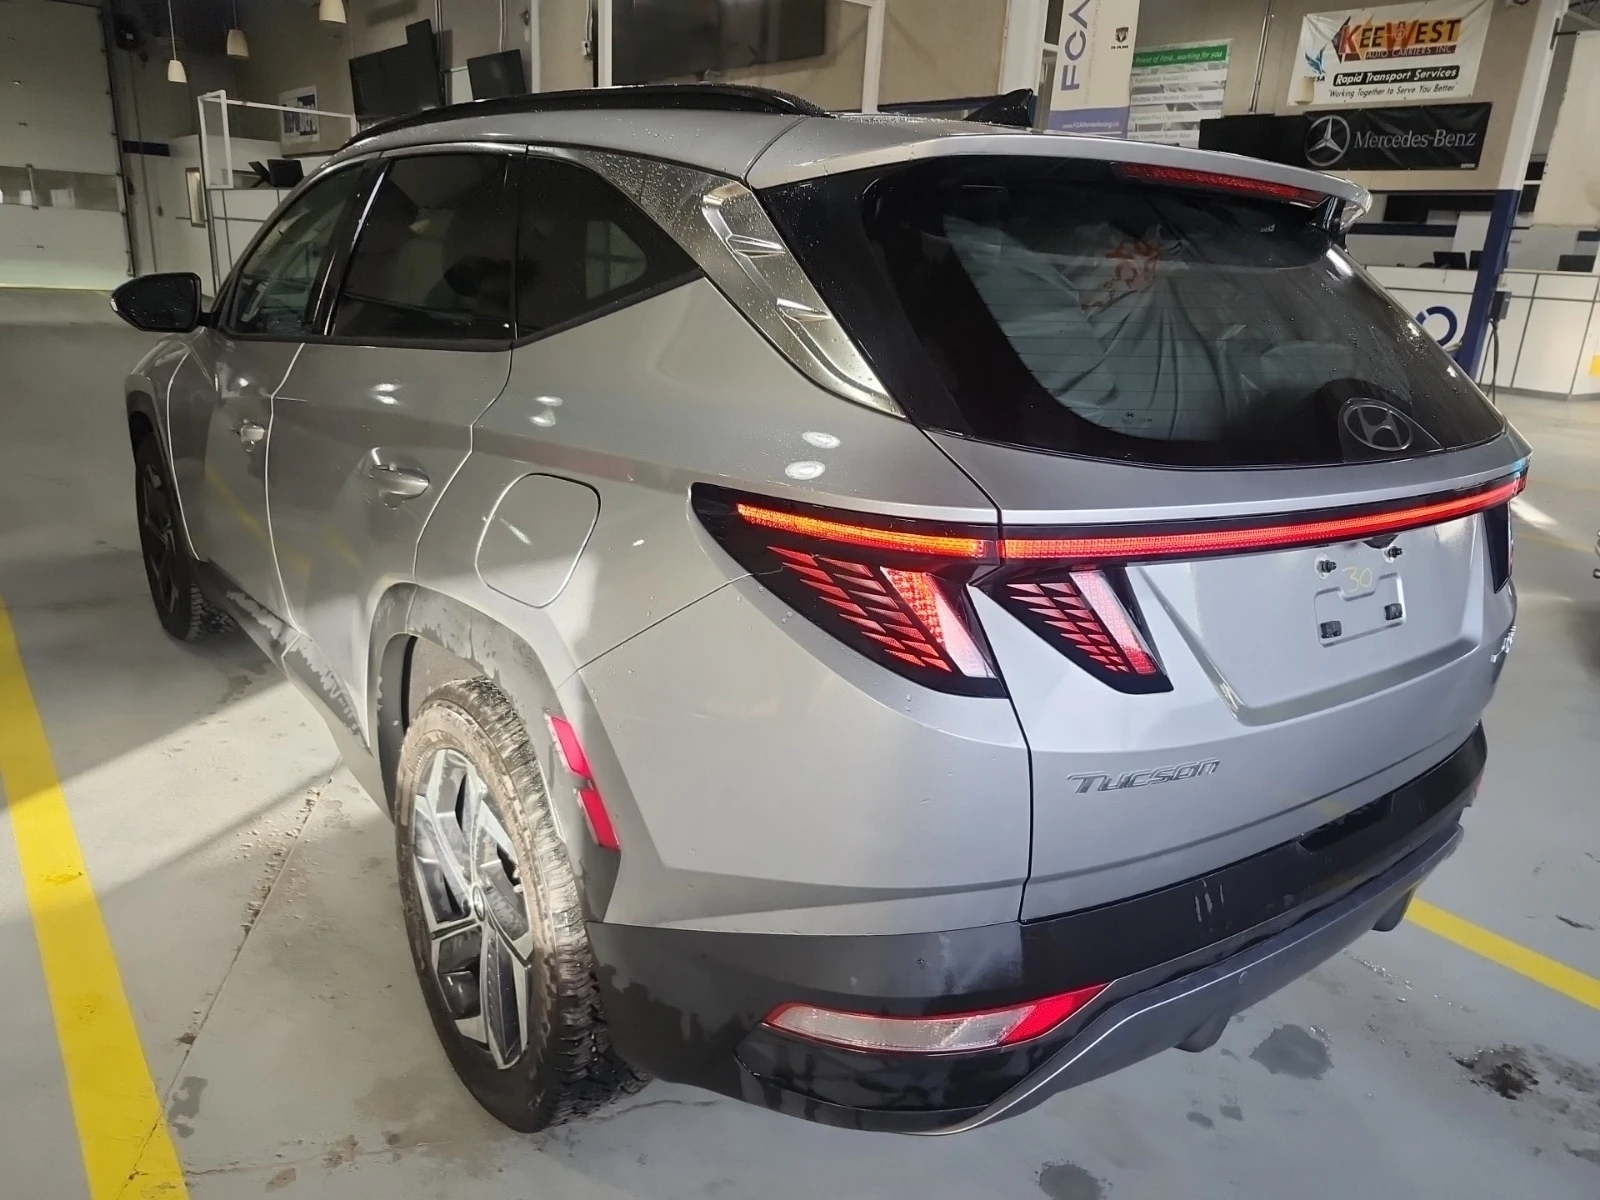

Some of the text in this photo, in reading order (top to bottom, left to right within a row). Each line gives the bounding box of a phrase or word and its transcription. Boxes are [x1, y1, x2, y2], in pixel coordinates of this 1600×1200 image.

[1061, 0, 1091, 91] FCA
[1366, 50, 1389, 59] AUTO
[1392, 46, 1432, 58] CARRIERS
[1209, 51, 1223, 59] you
[1335, 68, 1457, 85] Rapid Transport Services
[1357, 87, 1385, 97] Together
[1387, 87, 1394, 95] to
[1397, 86, 1416, 95] Serve
[1419, 85, 1431, 93] You
[1354, 129, 1477, 148] Mercedes-Benz
[1342, 566, 1372, 593] 30
[1066, 756, 1220, 794] TUCSON
